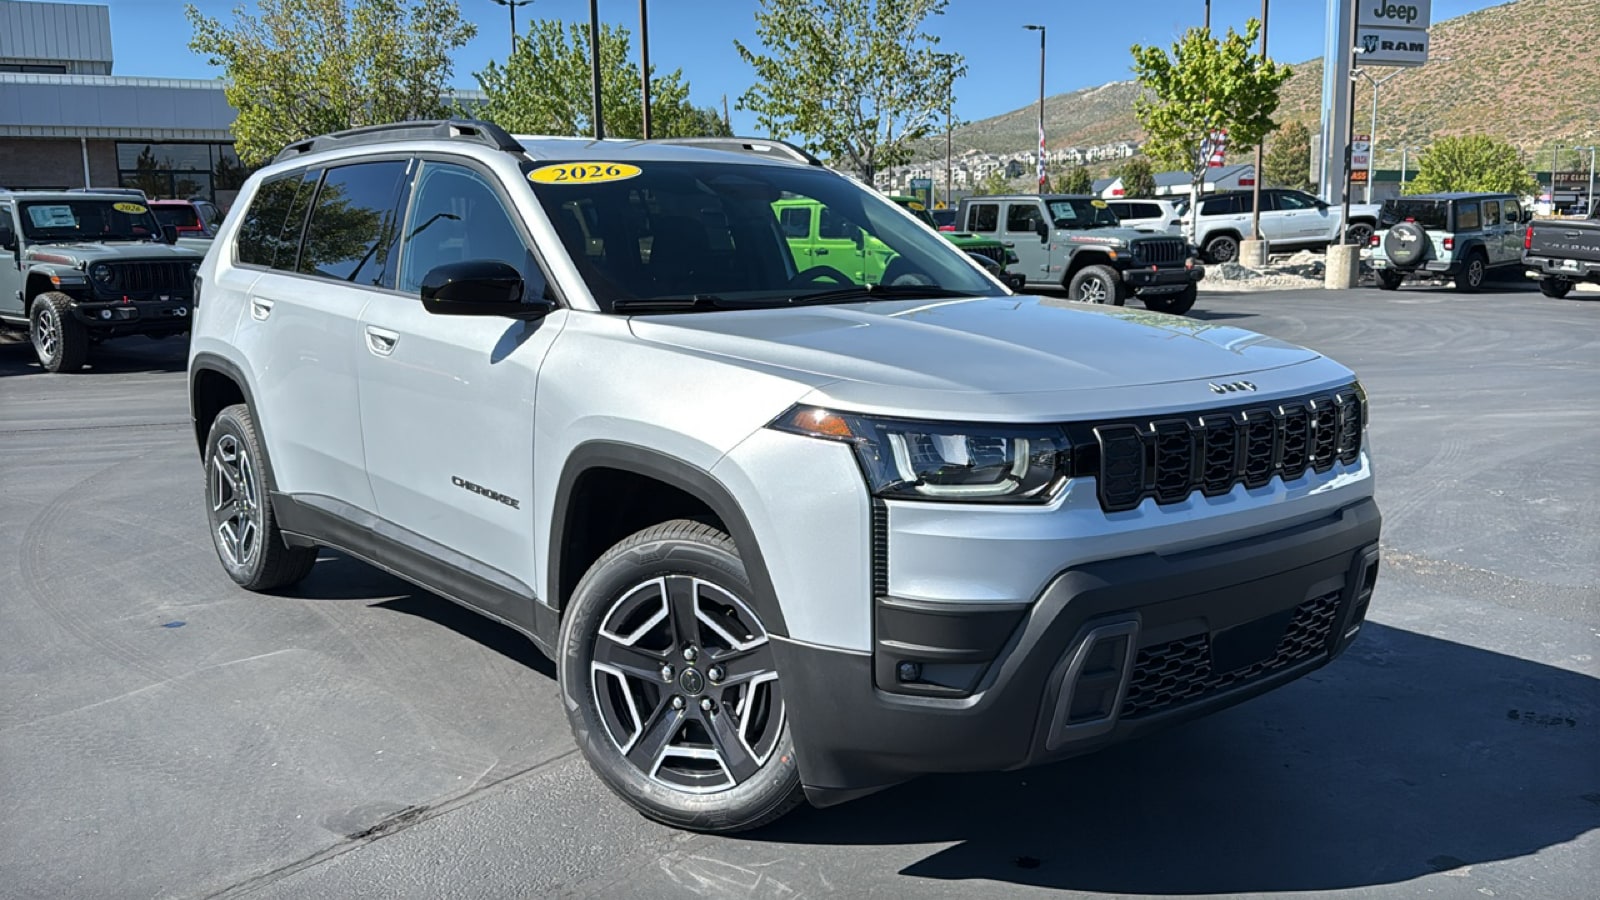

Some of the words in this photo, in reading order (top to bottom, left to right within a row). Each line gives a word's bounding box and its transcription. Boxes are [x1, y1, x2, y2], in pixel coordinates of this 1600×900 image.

[1374, 0, 1418, 24] Jeep
[1381, 41, 1424, 52] RAM
[552, 165, 621, 181] 2026
[118, 203, 142, 212] 2026
[1208, 381, 1257, 394] Jeep
[452, 475, 520, 510] CHEROKEE
